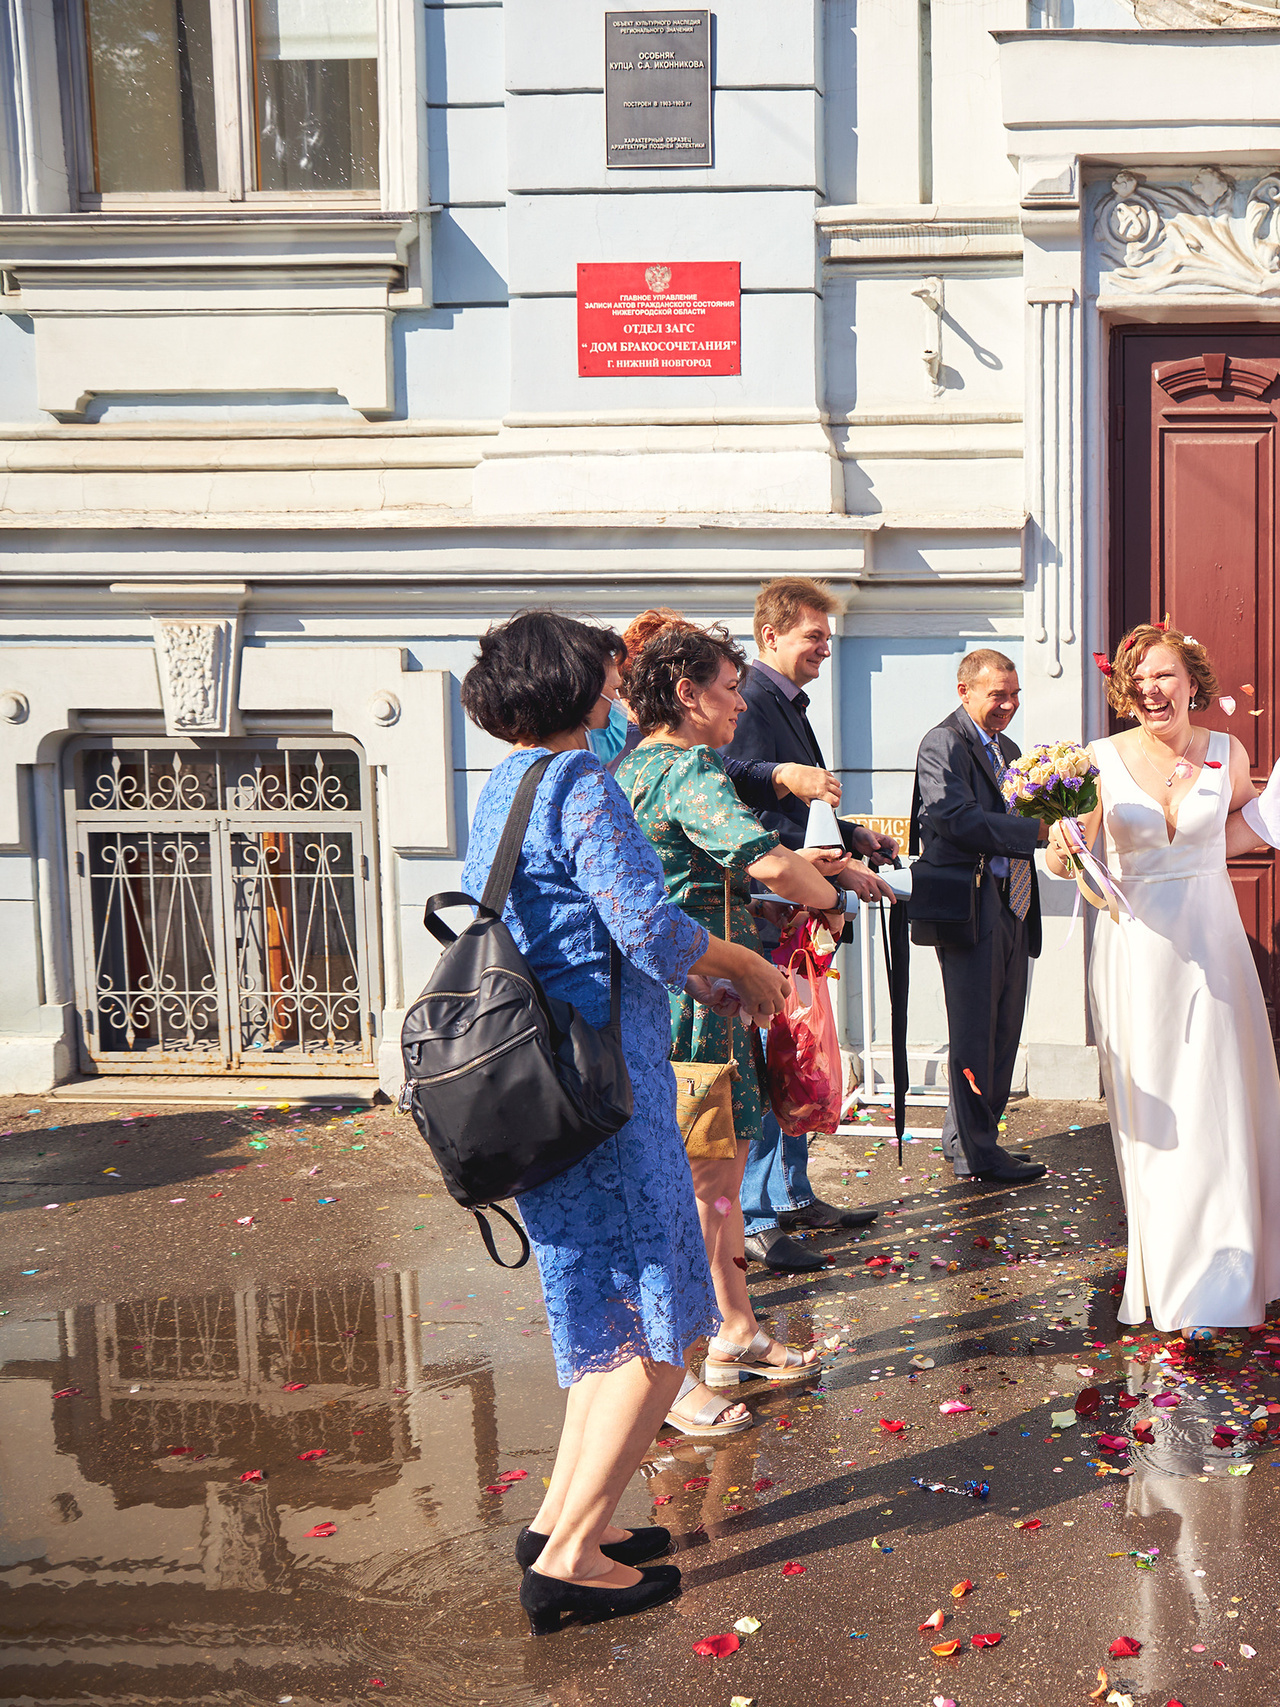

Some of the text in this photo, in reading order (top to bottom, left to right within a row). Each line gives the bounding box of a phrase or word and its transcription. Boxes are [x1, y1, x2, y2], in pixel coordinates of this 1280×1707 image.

[638, 52, 675, 60] ОСОБНЯК
[610, 62, 634, 71] КУПЦА
[654, 60, 704, 69] ИКОННИКОВА
[624, 136, 664, 144] ХАРАКТЕРНЫЙ
[624, 324, 695, 334] ОТДЕЛ ЗАГС
[616, 358, 659, 368] НИЖНИЙ
[662, 359, 711, 368] НОВГОРОД
